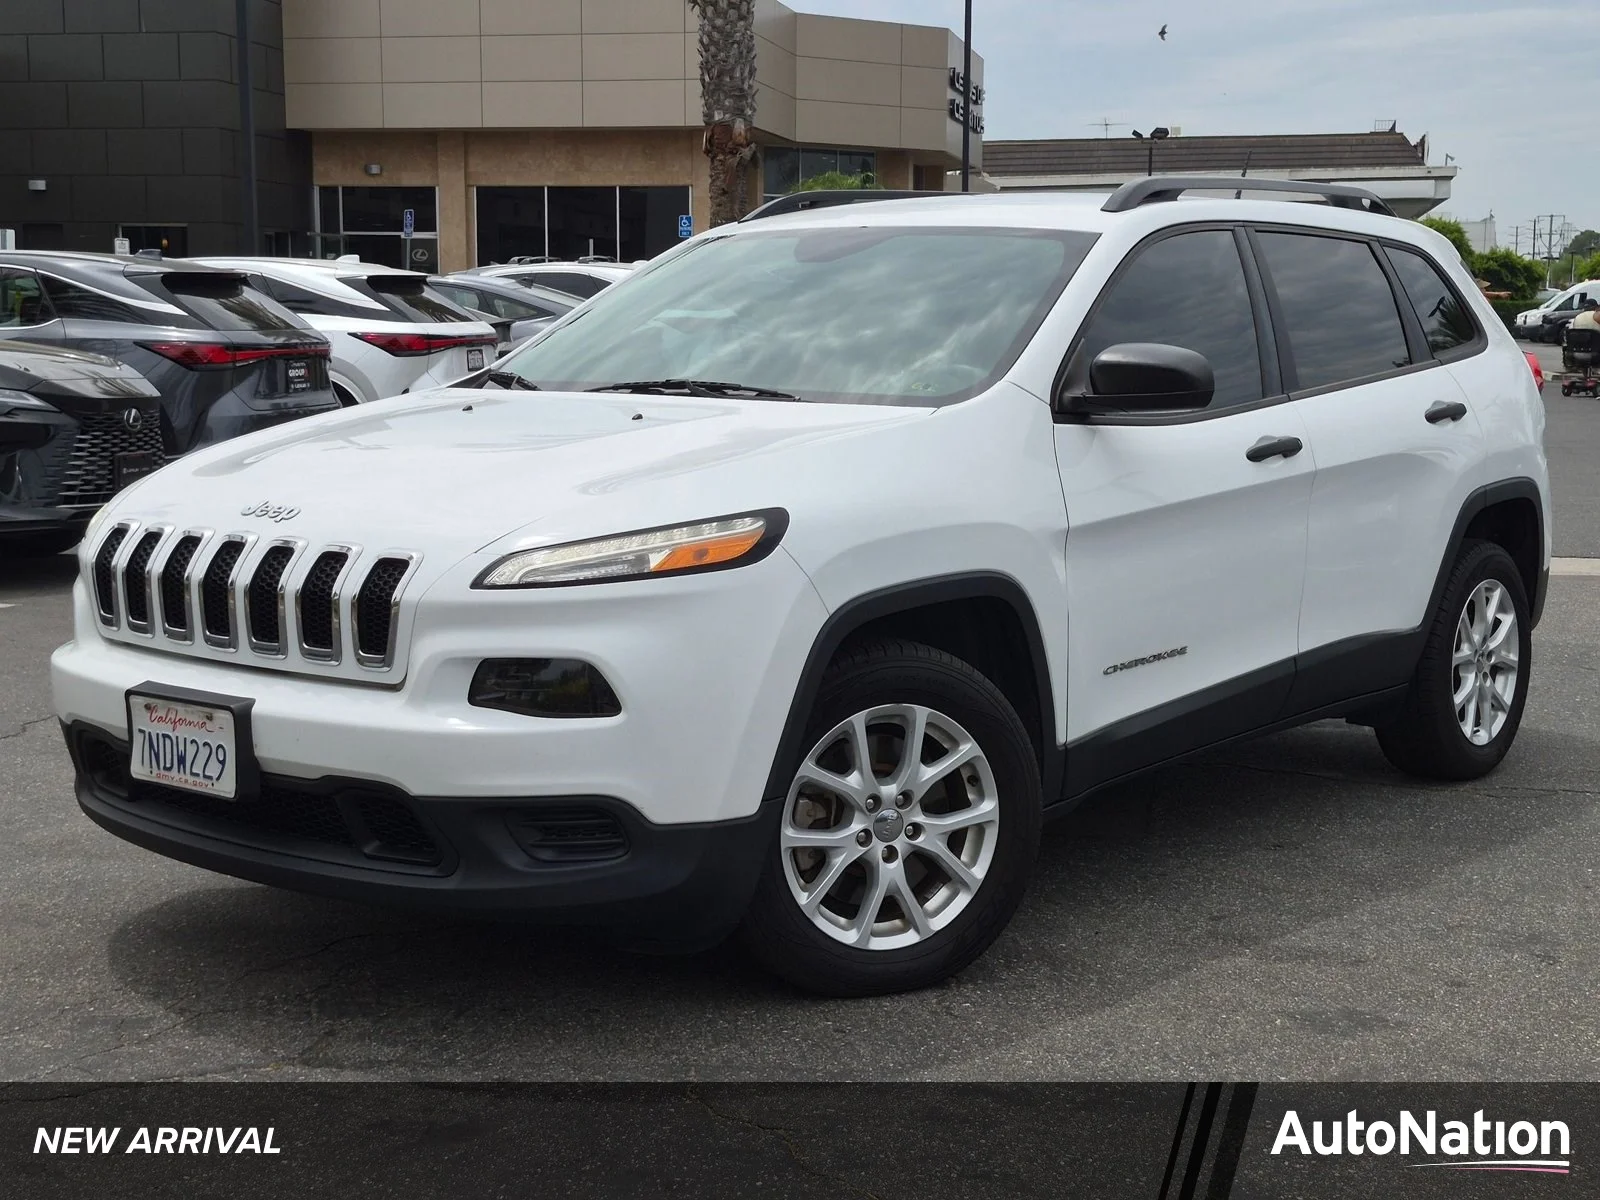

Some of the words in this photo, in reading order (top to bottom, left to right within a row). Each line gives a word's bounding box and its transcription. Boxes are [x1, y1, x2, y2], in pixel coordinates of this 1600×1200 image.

[240, 499, 301, 523] Jeep
[1103, 645, 1188, 675] CHEROKEE
[149, 704, 215, 732] California
[138, 728, 226, 781] 7NDW229
[156, 772, 209, 787] dmv.ca.gov
